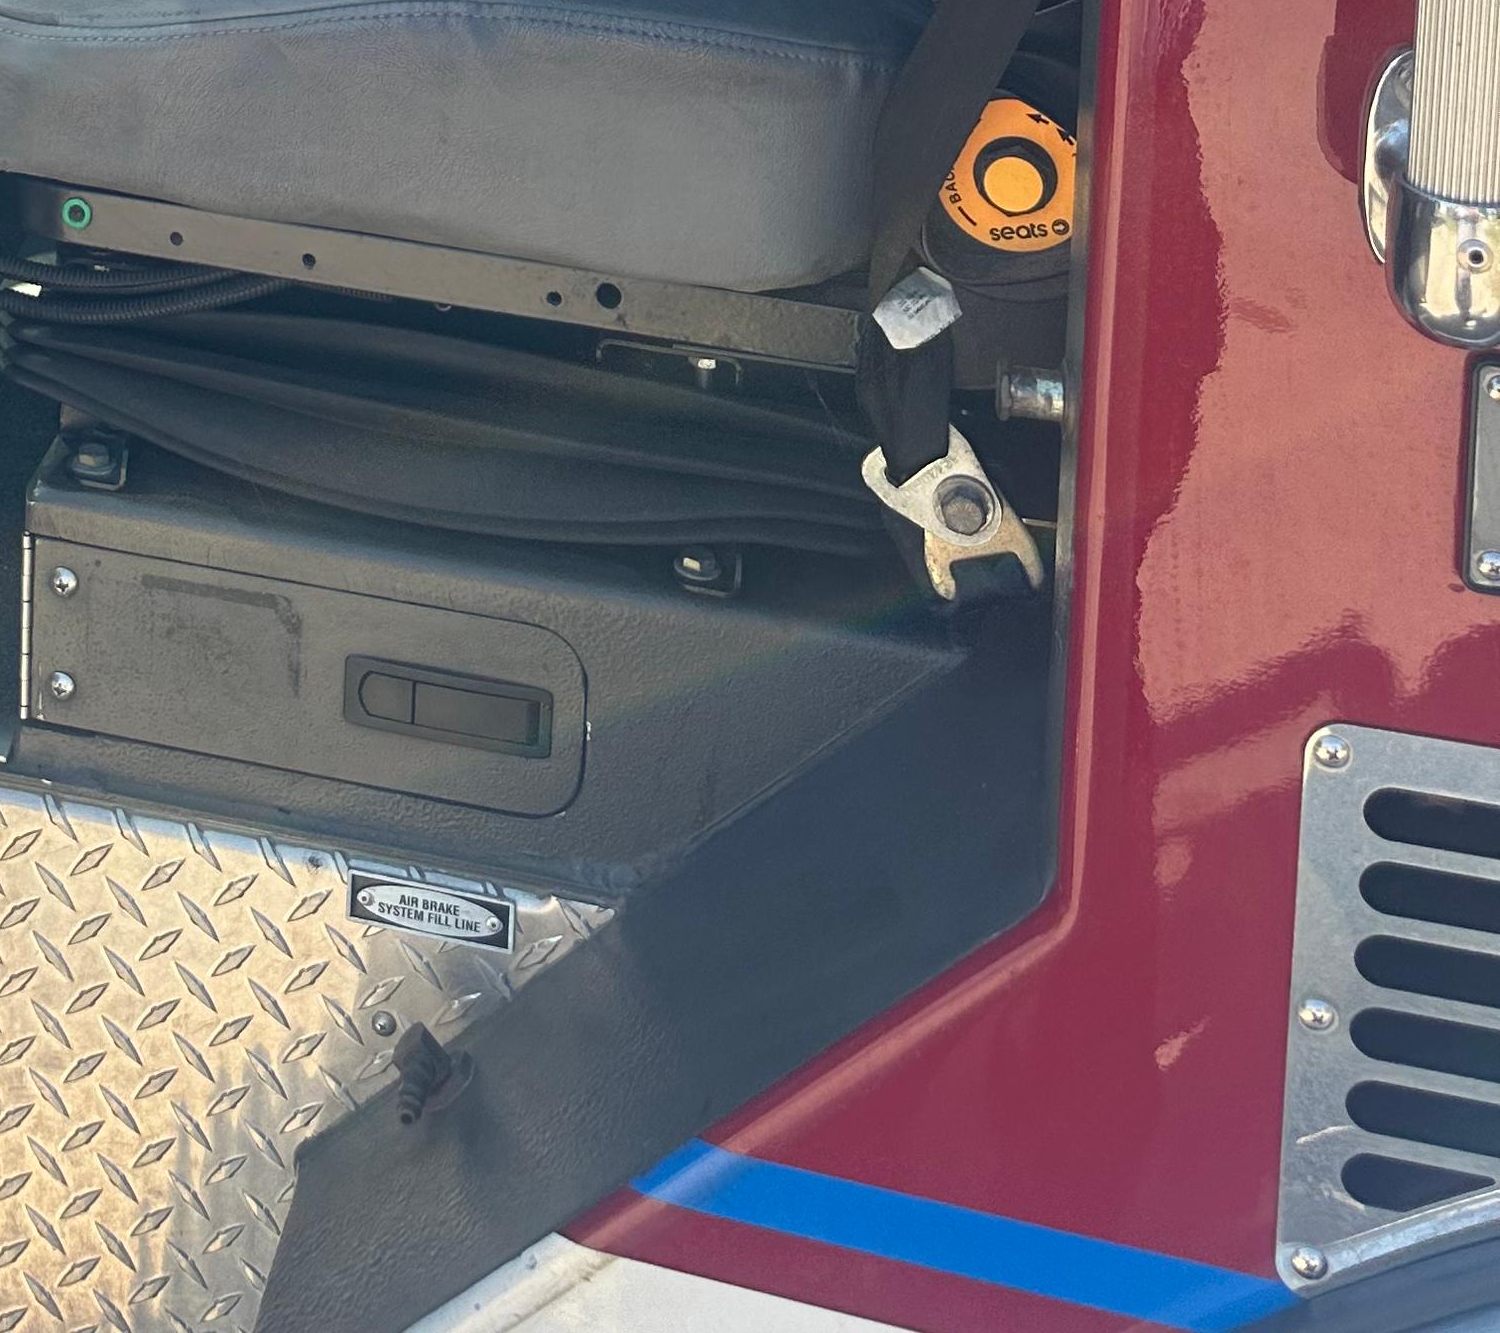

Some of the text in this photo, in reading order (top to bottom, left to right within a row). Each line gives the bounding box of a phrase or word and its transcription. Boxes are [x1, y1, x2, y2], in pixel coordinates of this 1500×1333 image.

[945, 169, 962, 204] BAC
[989, 223, 1048, 241] seats
[378, 902, 481, 932] SYSTEM FILL LINE
[399, 895, 460, 916] AIR BRAKE
